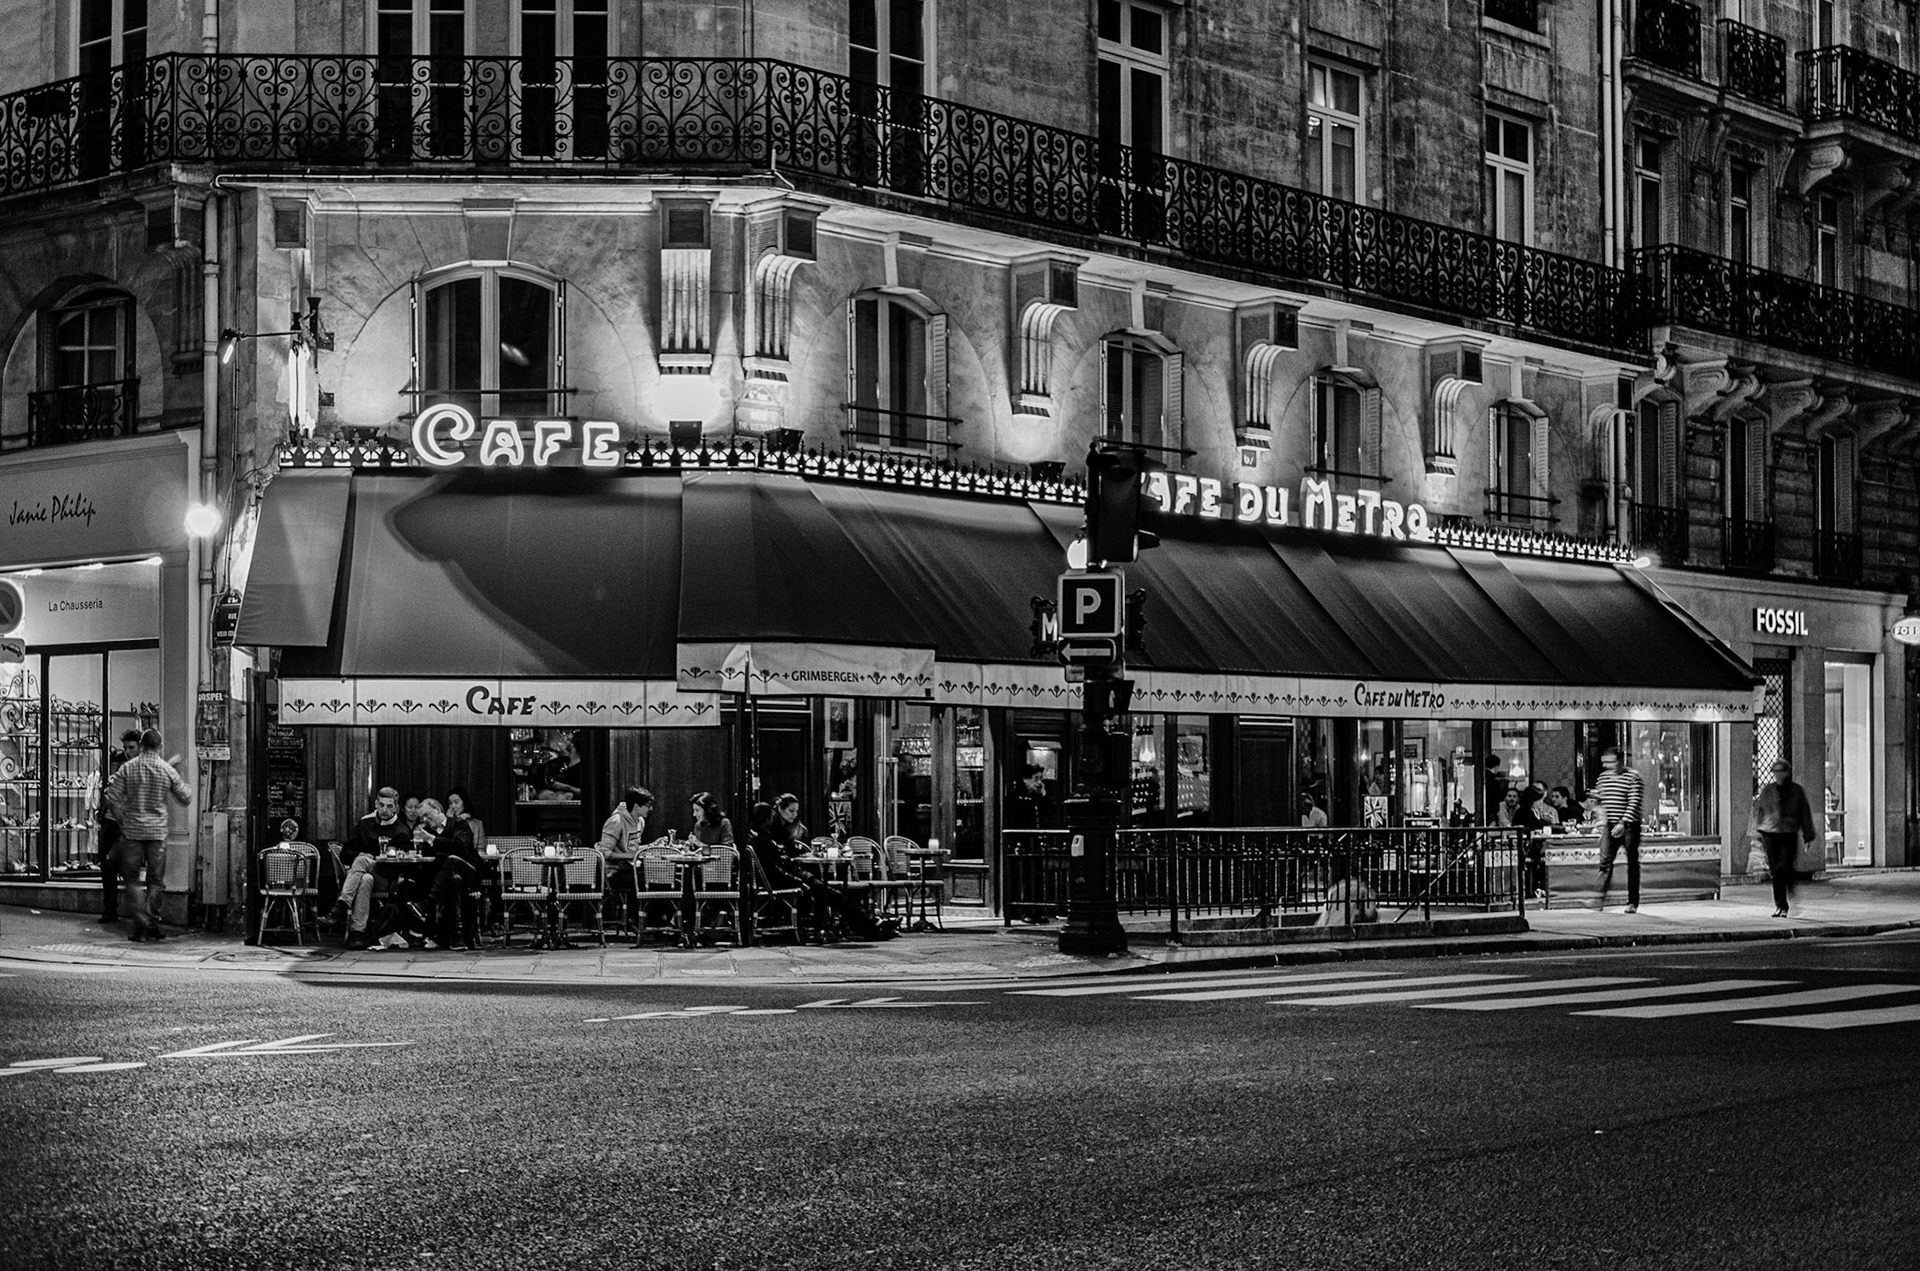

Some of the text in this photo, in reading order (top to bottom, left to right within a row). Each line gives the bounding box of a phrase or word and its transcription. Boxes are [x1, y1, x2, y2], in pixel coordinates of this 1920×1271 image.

[9, 492, 96, 527] Janie Philip
[1140, 471, 1428, 543] AFE DU METRO
[48, 599, 103, 612] La Chausseria
[1076, 588, 1101, 624] P
[1756, 607, 1809, 636] FOSSIL
[791, 671, 859, 683] GRIMBERGEN
[1387, 692, 1403, 707] DU
